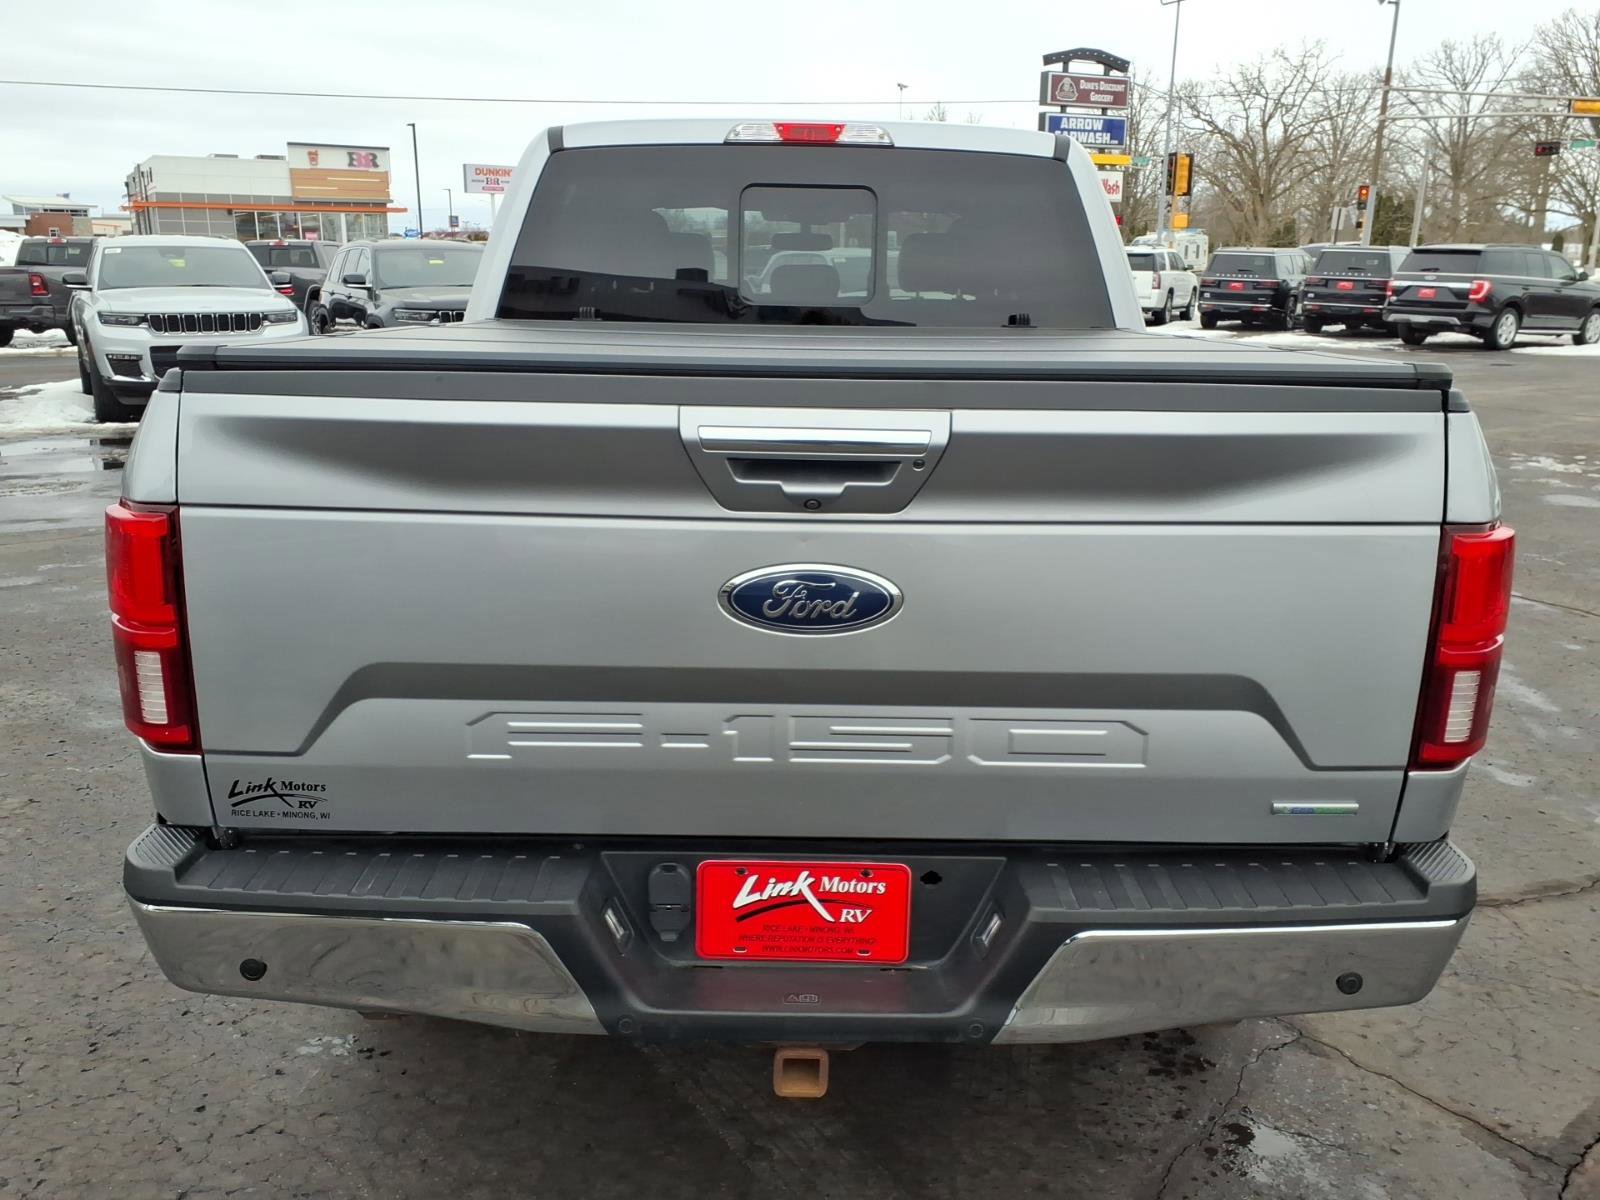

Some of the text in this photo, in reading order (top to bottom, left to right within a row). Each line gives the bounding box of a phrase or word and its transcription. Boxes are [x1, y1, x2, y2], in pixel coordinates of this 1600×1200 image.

[1060, 117, 1104, 130] ARROW
[762, 579, 859, 619] Ford
[467, 711, 1149, 769] F-150
[228, 777, 326, 808] Link Motors
[231, 809, 251, 817] RICE
[253, 810, 276, 818] LAKE
[282, 811, 319, 820] MINONG,
[298, 800, 317, 809] RV
[732, 870, 887, 923] Link Motors
[838, 908, 873, 923] RV
